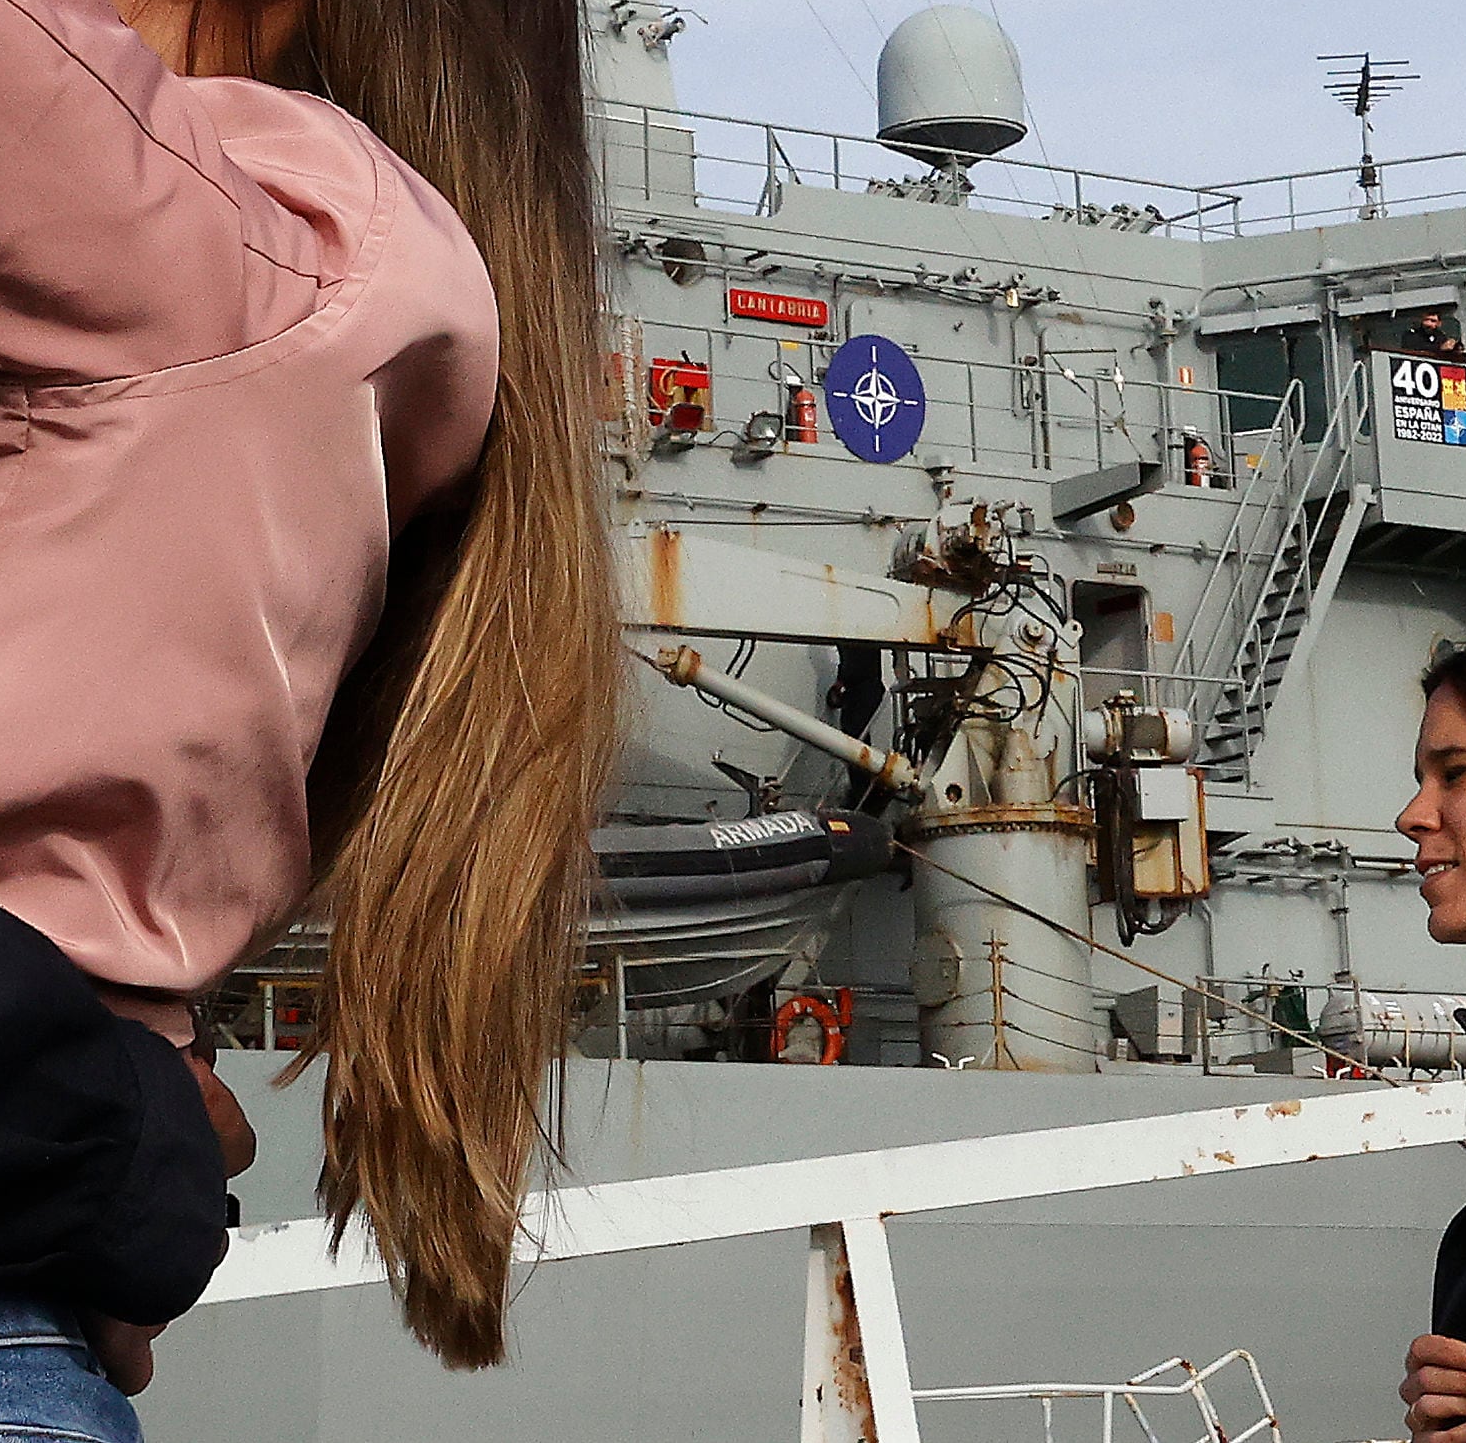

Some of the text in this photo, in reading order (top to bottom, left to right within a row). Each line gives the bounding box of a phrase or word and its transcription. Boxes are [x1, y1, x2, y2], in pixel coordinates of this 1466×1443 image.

[737, 294, 820, 318] CANTABRIA
[1393, 360, 1438, 398] 40
[1395, 405, 1441, 422] ESPAÑA
[1396, 419, 1441, 432] EN LA OTAN
[1397, 428, 1443, 443] 1982-2022
[711, 813, 814, 848] ARMADA
